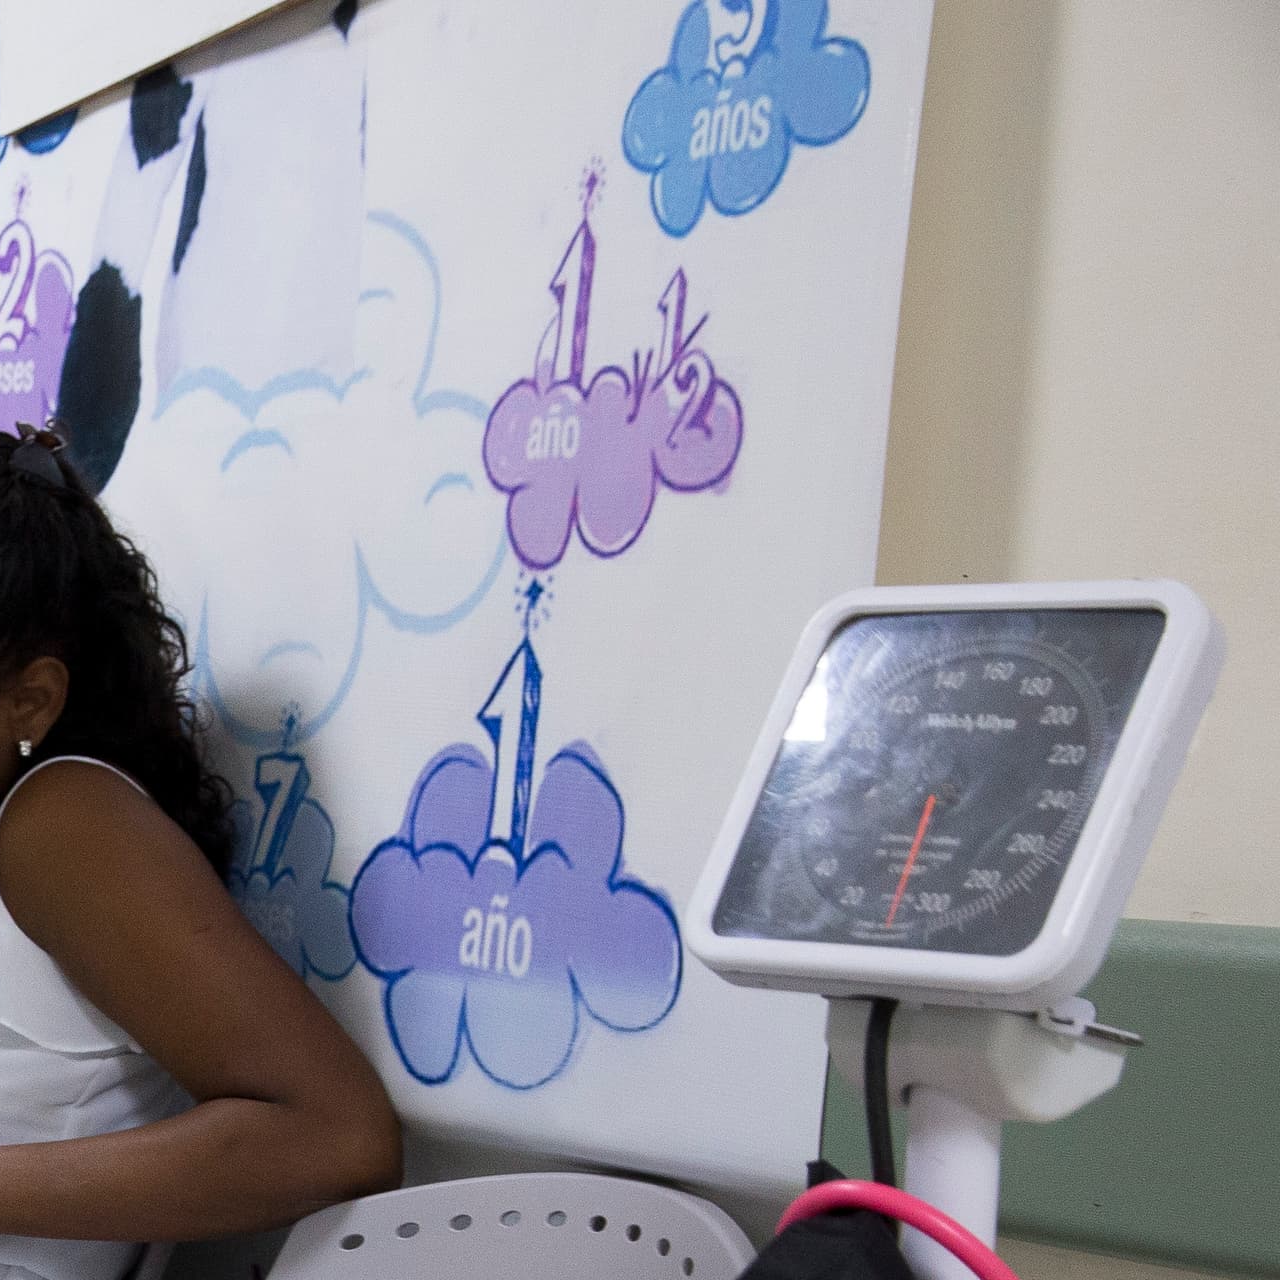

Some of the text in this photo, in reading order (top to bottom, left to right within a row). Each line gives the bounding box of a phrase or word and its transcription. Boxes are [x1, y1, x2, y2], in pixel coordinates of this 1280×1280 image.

[690, 88, 773, 160] años
[526, 402, 580, 460] año
[476, 638, 542, 878] 1
[255, 752, 311, 882] 7
[459, 895, 533, 978] año
